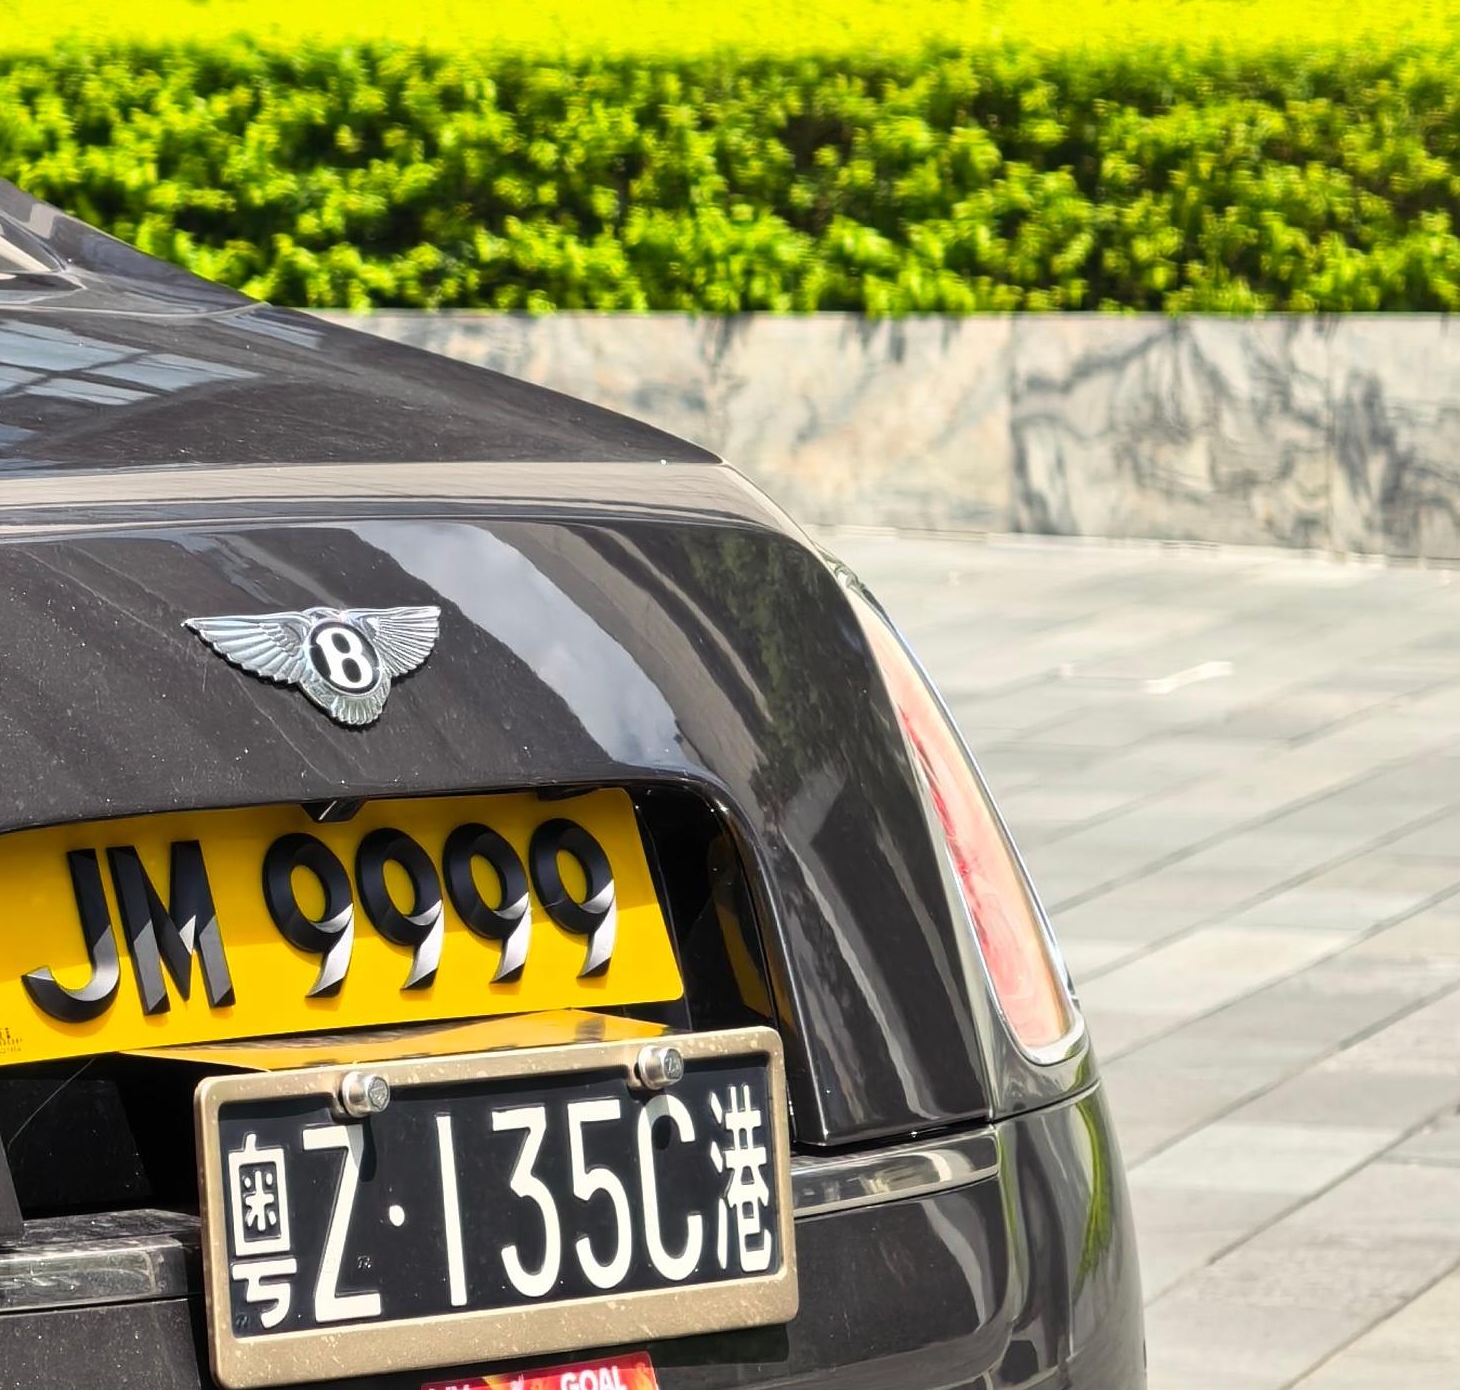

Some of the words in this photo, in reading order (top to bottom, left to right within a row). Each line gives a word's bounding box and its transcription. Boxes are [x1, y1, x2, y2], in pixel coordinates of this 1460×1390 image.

[316, 626, 374, 689] B
[21, 839, 236, 1023] JM
[262, 817, 617, 998] 9999
